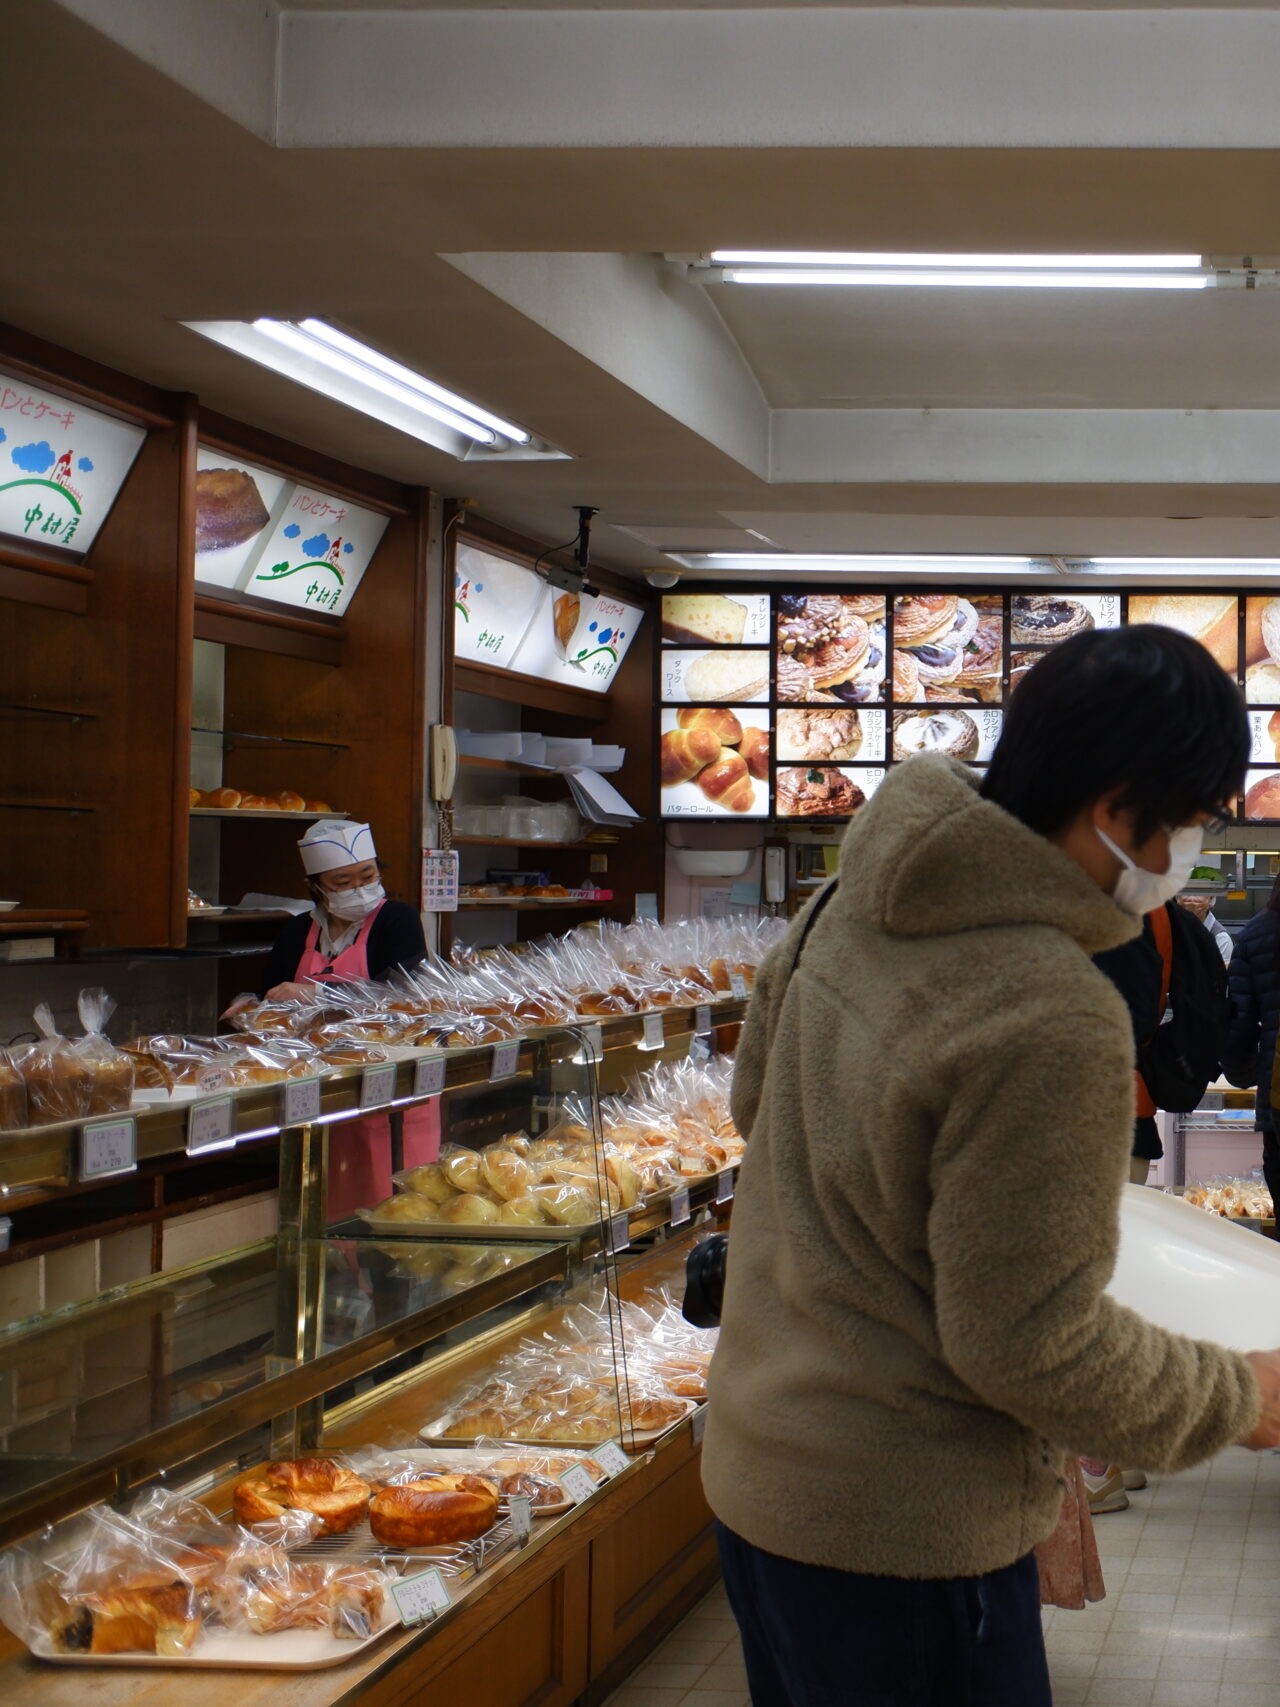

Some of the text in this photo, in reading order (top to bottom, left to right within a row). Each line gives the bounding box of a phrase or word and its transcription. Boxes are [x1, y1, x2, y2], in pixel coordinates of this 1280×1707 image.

[25, 503, 80, 544] 中村屋
[293, 495, 347, 522] パンとケーキ
[305, 580, 342, 610] 中村屋
[759, 597, 767, 629] オレンジ
[477, 629, 505, 653] 中村屋
[666, 673, 674, 697] ワース
[874, 711, 882, 757] ロシアケーキ
[983, 711, 991, 742] ホワイト
[667, 805, 714, 813] バターロール
